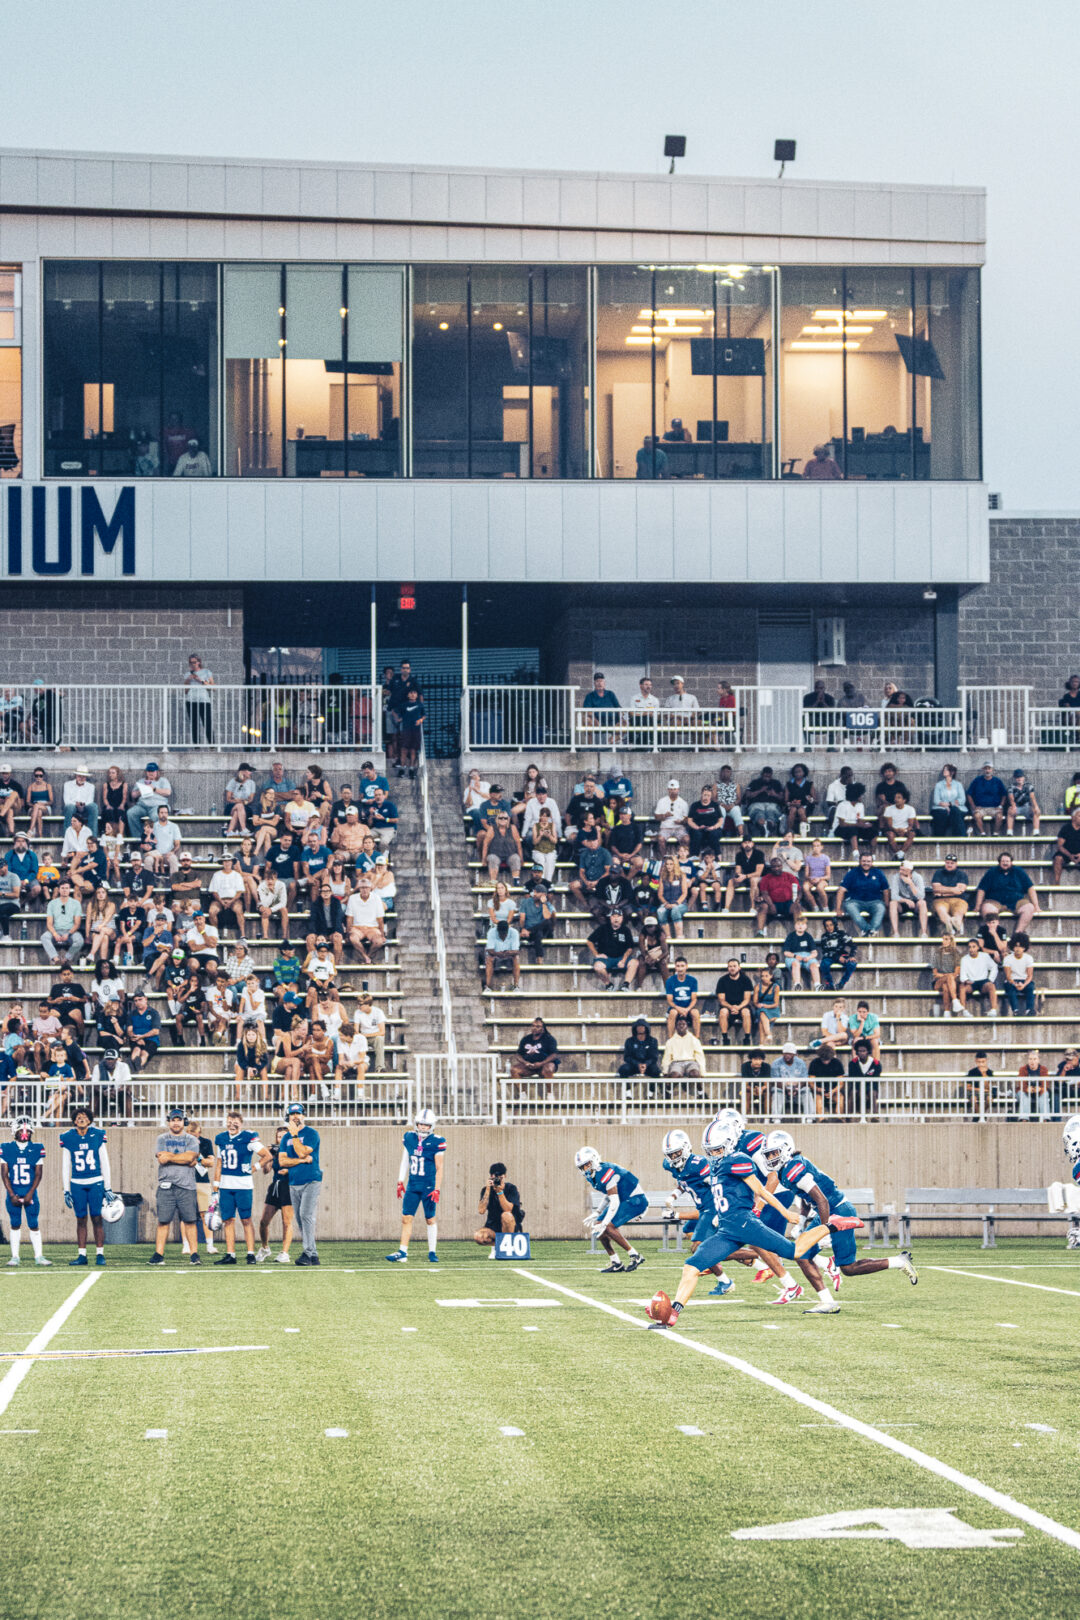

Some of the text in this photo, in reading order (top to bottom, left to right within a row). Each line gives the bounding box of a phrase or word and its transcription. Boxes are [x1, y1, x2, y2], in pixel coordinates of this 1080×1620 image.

[8, 486, 136, 576] IUM
[849, 712, 875, 726] 106
[74, 1149, 97, 1172] 54
[220, 1149, 238, 1170] 10
[410, 1155, 426, 1177] 81
[12, 1164, 31, 1185] 15
[499, 1233, 528, 1257] 40
